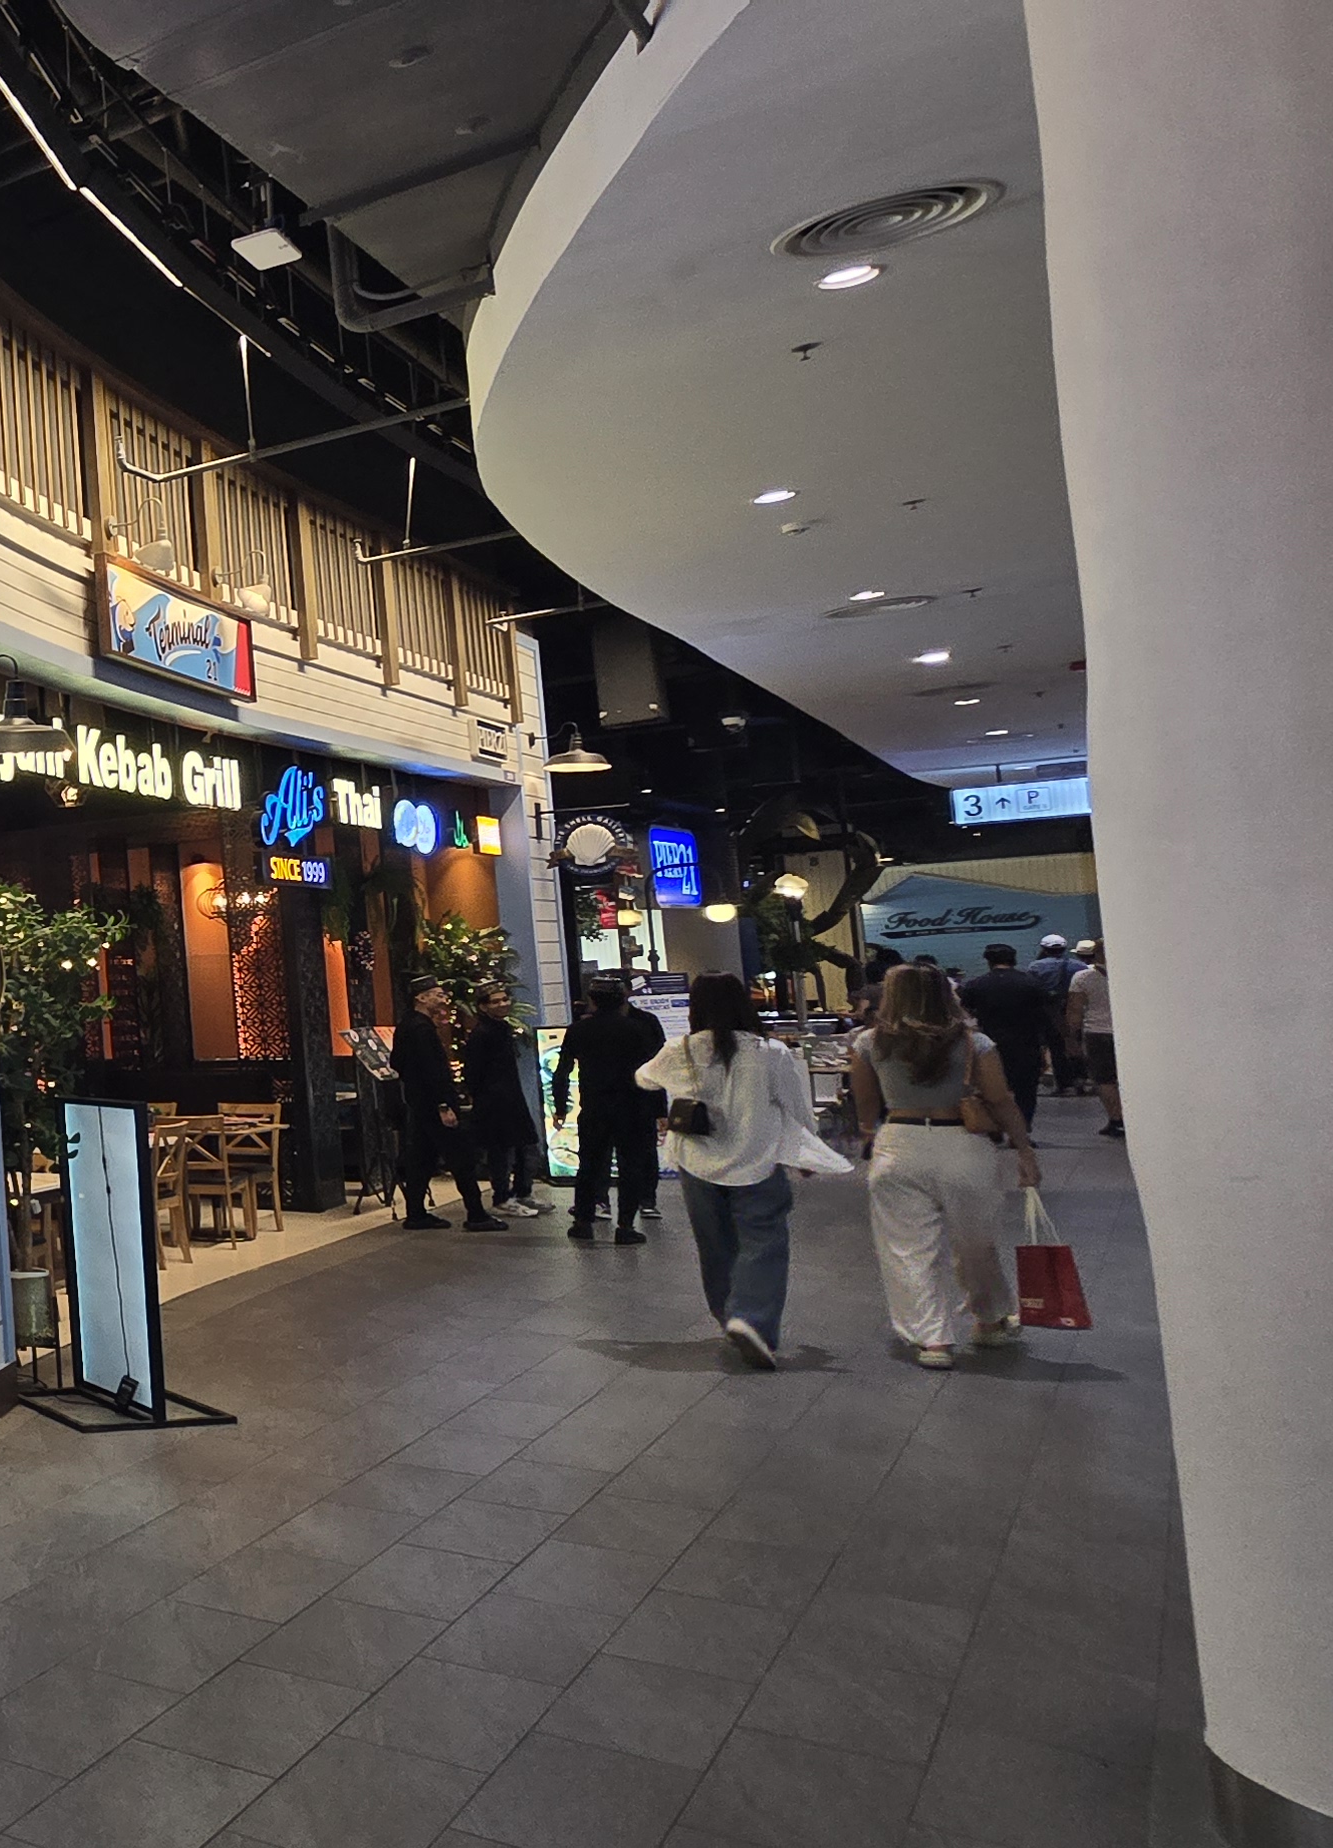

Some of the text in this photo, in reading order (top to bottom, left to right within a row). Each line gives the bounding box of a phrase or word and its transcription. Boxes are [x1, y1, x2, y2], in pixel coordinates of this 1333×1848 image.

[145, 604, 211, 662] Terminal
[205, 658, 219, 682] 21
[76, 724, 174, 800] Kebab
[182, 750, 243, 811] Grill
[260, 765, 325, 847] Ali's
[332, 777, 383, 830] Thai
[963, 790, 1039, 817] 3 P
[269, 856, 327, 884] SINCE 1999
[884, 905, 1038, 930] Food House
